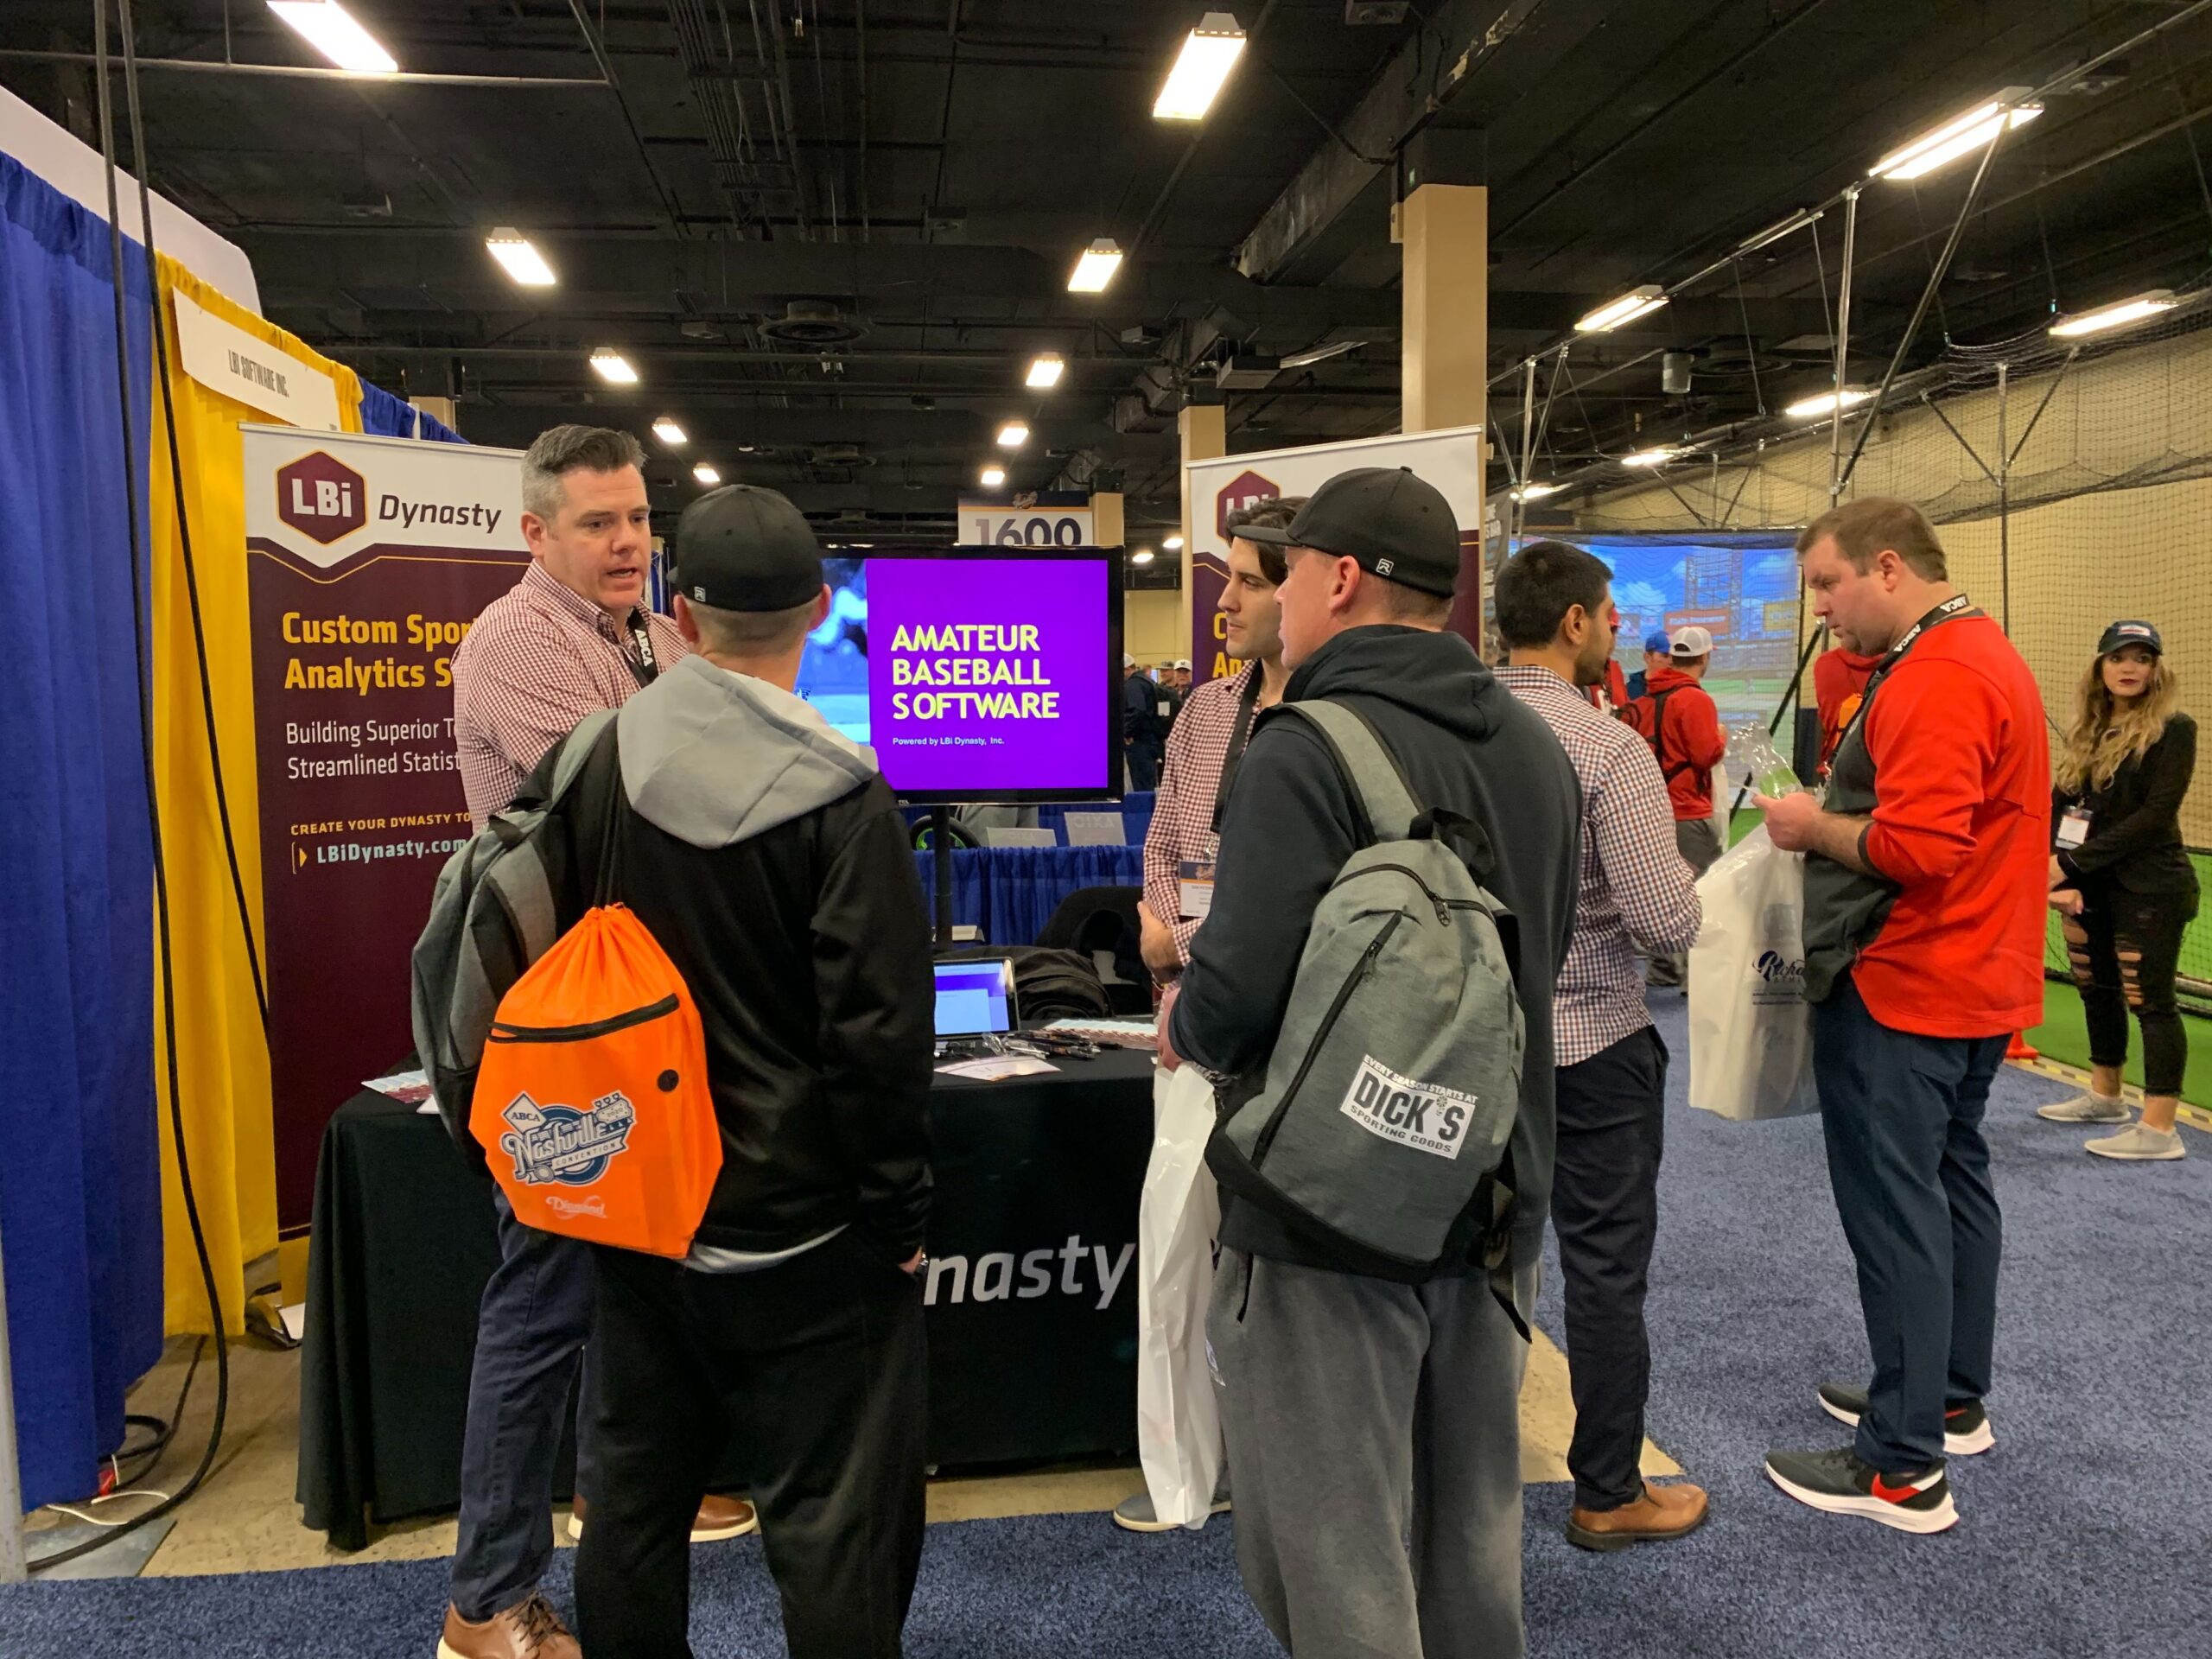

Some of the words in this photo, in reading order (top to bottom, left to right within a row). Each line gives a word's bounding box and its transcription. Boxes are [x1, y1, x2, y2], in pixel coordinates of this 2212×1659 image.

[227, 348, 240, 375] LBI
[241, 354, 276, 392] SOFTWARE
[276, 372, 290, 397] INC.
[291, 478, 352, 518] LBi
[378, 494, 502, 533] Dynasty
[975, 518, 1082, 545] 1600
[1939, 596, 1967, 613] ABCA
[282, 612, 397, 644] Custom
[406, 613, 477, 652] Spor
[890, 624, 1041, 652] AMATEUR
[1893, 624, 1922, 652] ABCA
[634, 629, 654, 666] ABCA
[283, 657, 426, 696] Analytics
[892, 658, 1051, 686] BASEBALL
[892, 692, 1060, 720] SOFTWARE
[286, 721, 361, 747] Building
[365, 719, 439, 746] Superior
[929, 737, 938, 747] by
[954, 737, 987, 747] Dynasty,
[288, 752, 397, 779] Streamlined
[403, 750, 461, 773] Statist
[290, 821, 344, 836] CREATE
[347, 818, 386, 830] YOUR
[390, 814, 452, 828] DYNASTY
[454, 812, 471, 823] TO
[1363, 1054, 1394, 1077] EVERY
[1392, 1073, 1429, 1090] SEASON
[1429, 1084, 1465, 1100] STARTS
[1464, 1095, 1478, 1104] AT
[511, 1111, 541, 1122] ABCA
[1350, 1104, 1407, 1139] SPORTING
[1410, 1135, 1452, 1153] GOODS
[501, 1114, 607, 1180] Nashville
[556, 1142, 616, 1166] CONVENTION
[924, 1235, 1137, 1311] nasty
